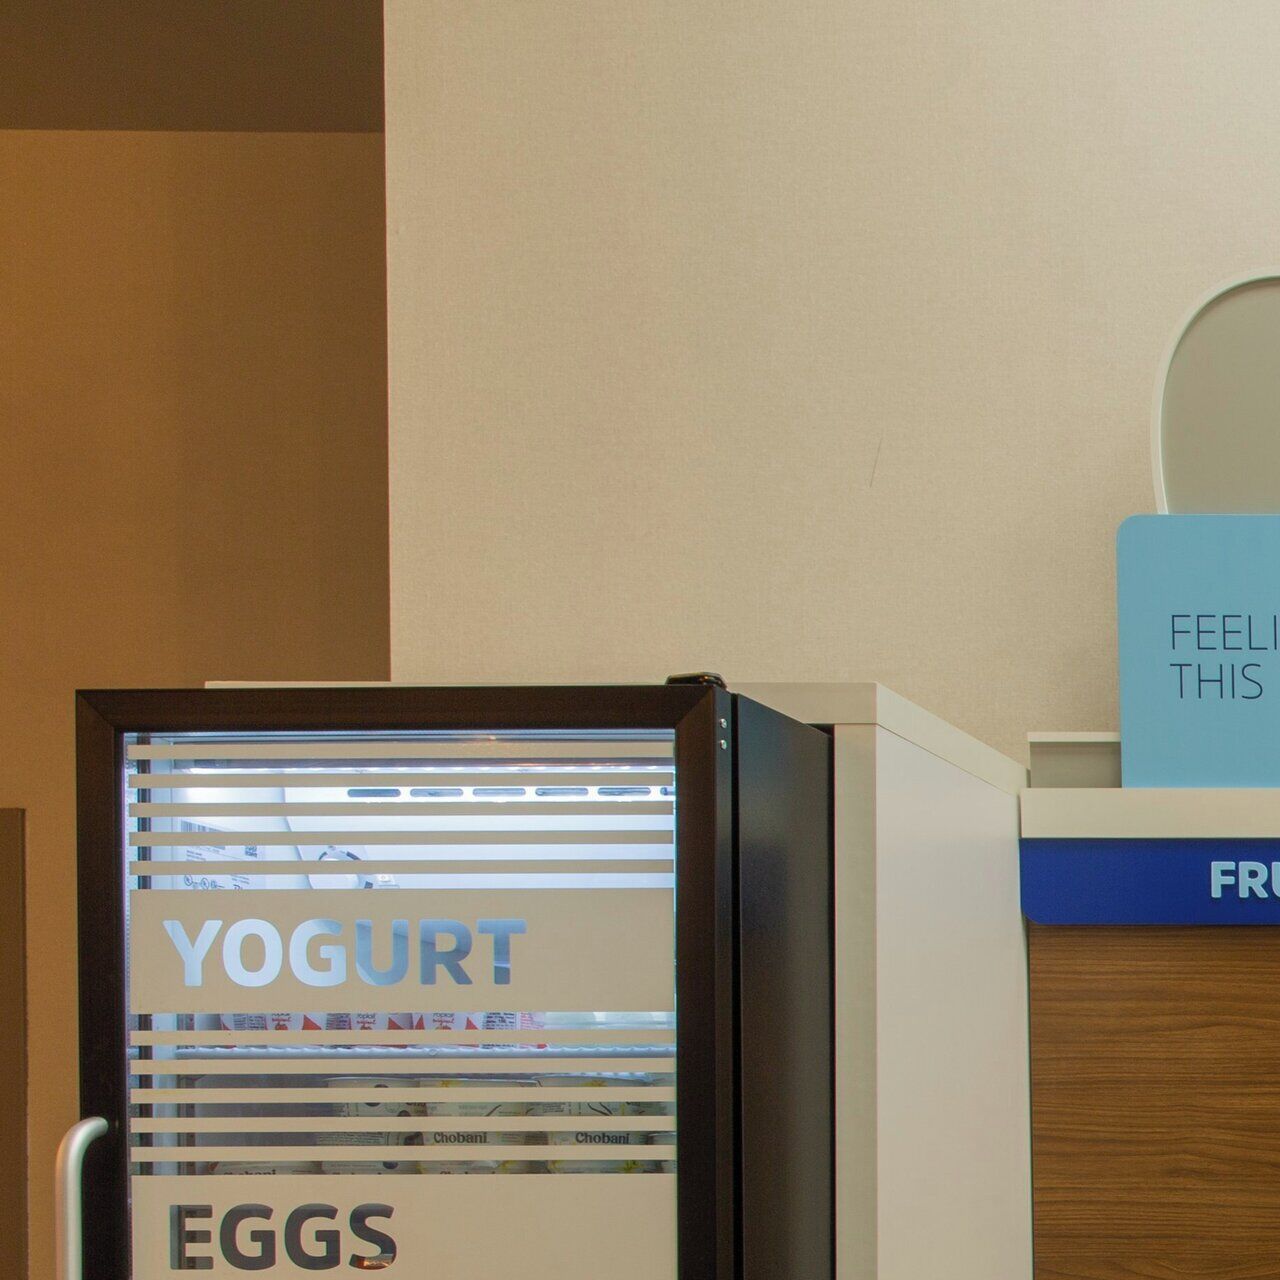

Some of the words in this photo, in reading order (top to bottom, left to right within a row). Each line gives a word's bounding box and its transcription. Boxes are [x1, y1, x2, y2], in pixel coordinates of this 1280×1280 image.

[1169, 663, 1264, 700] THIS
[163, 919, 527, 988] YOGURT
[433, 1131, 488, 1145] Chobani
[575, 1131, 631, 1146] Chobani
[169, 1204, 397, 1271] EGGS
